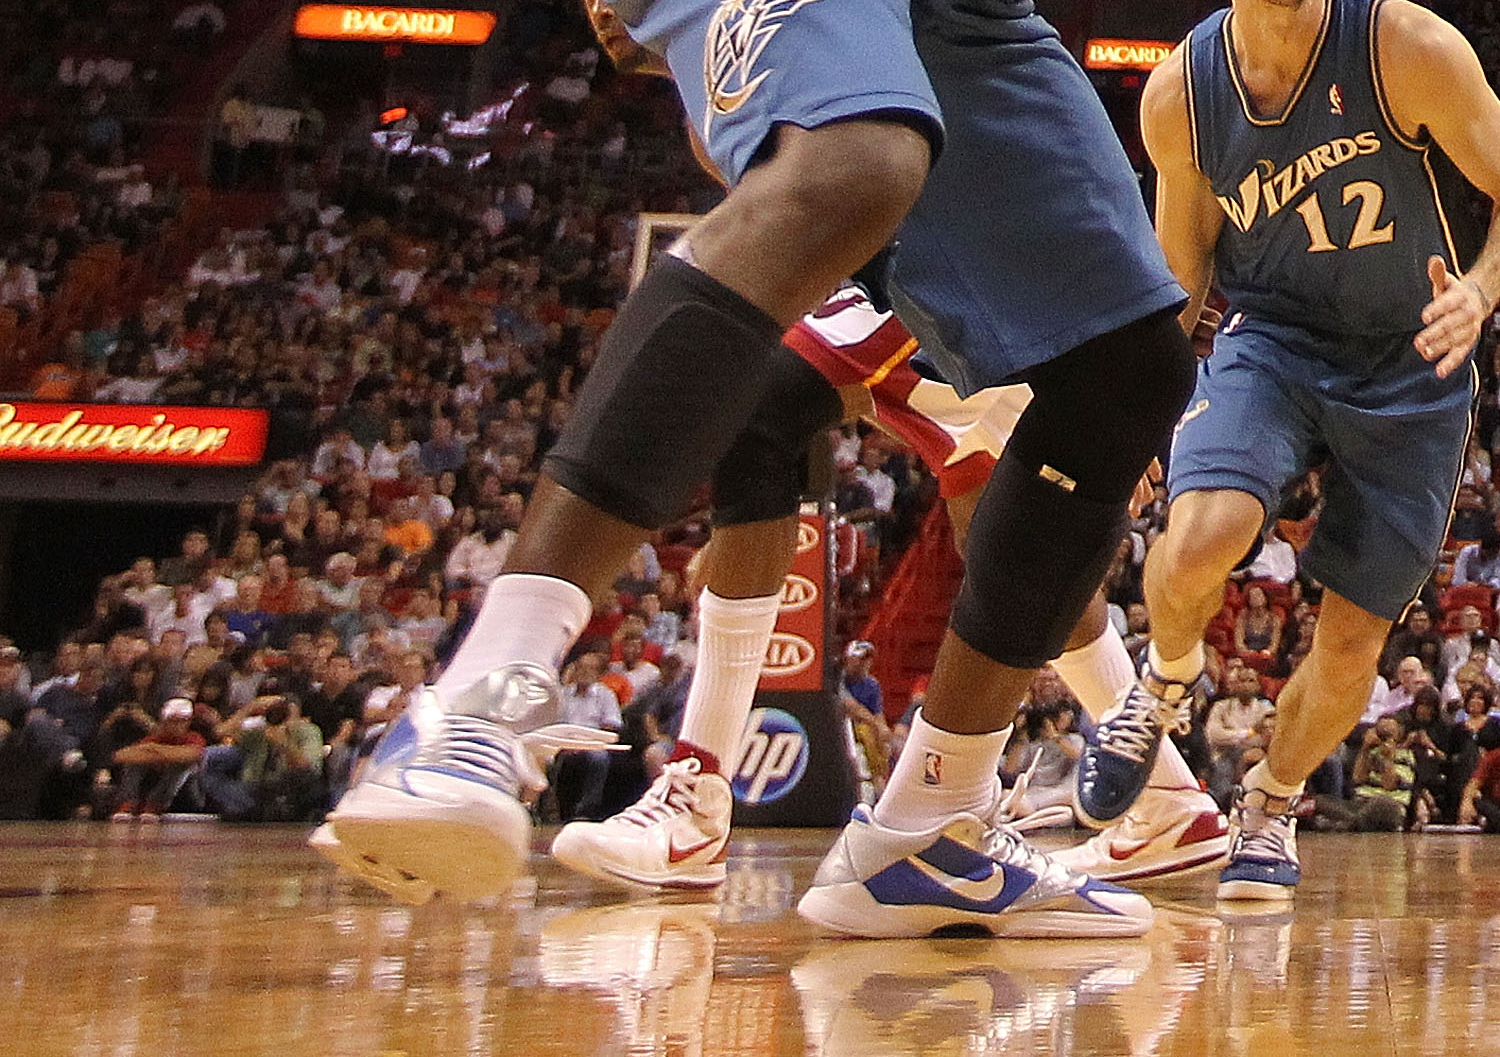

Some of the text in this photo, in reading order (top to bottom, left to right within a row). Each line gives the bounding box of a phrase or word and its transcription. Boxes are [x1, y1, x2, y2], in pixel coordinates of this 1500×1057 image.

[340, 9, 456, 36] BACARDI
[1215, 130, 1381, 232] WIZARDS
[1296, 180, 1395, 252] 12
[764, 642, 802, 665] IA
